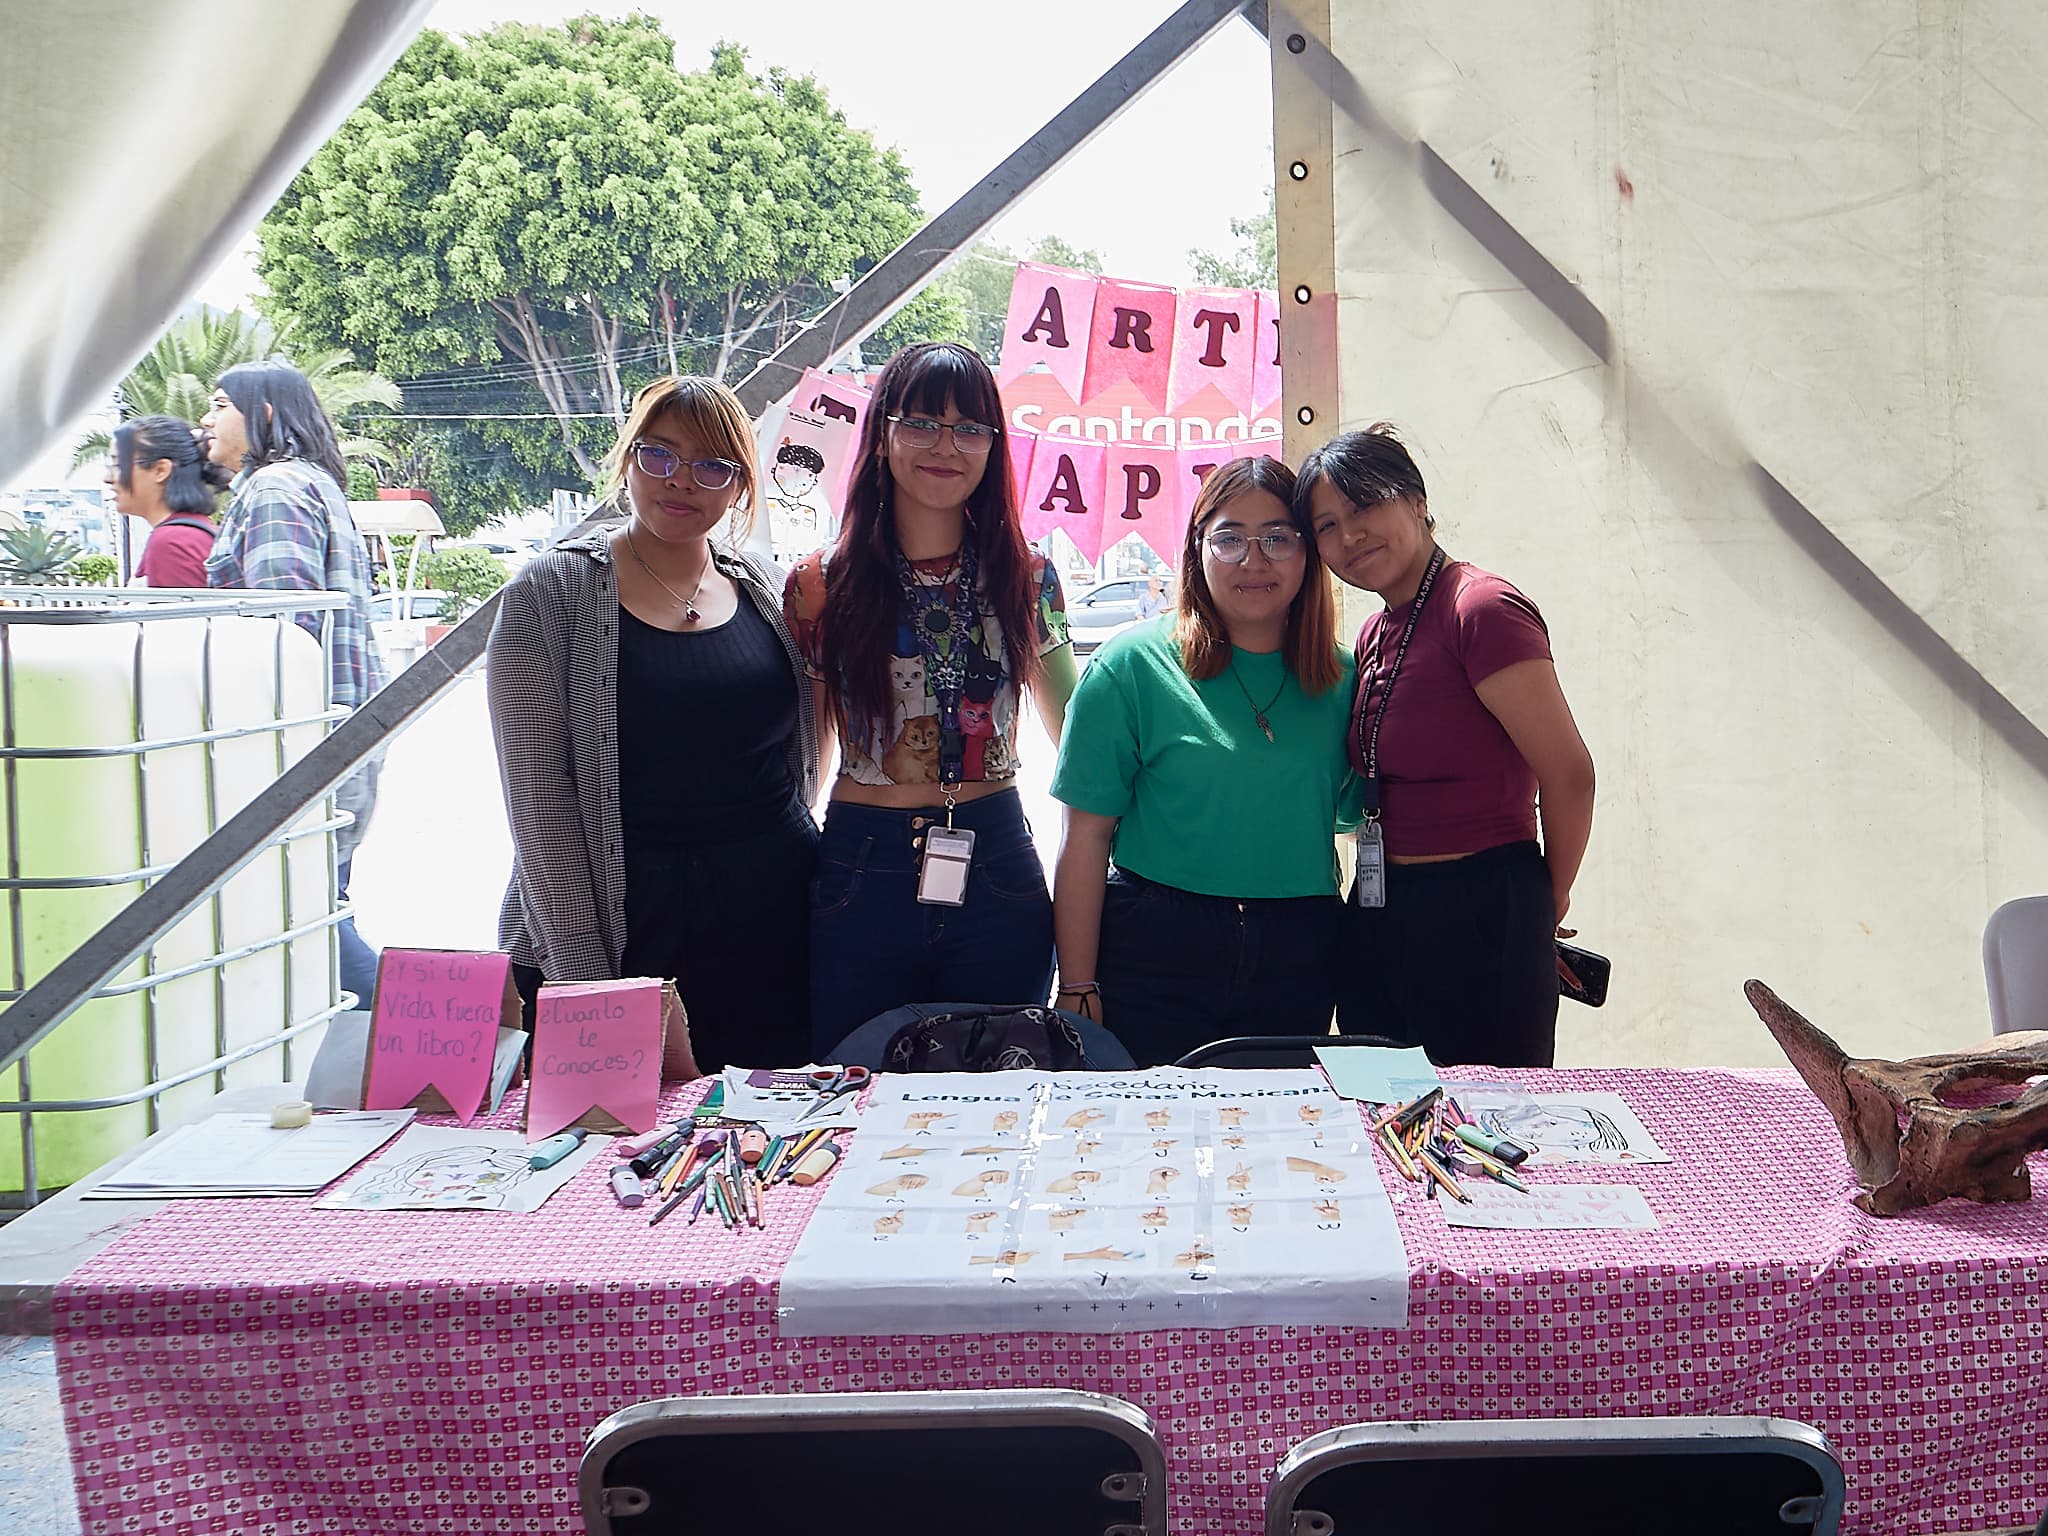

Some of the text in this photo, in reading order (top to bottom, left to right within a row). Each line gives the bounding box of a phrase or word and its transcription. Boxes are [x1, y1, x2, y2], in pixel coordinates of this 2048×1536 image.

[384, 991, 437, 1020] Vida
[377, 1031, 404, 1053] un
[902, 1093, 1021, 1103] Lengua
